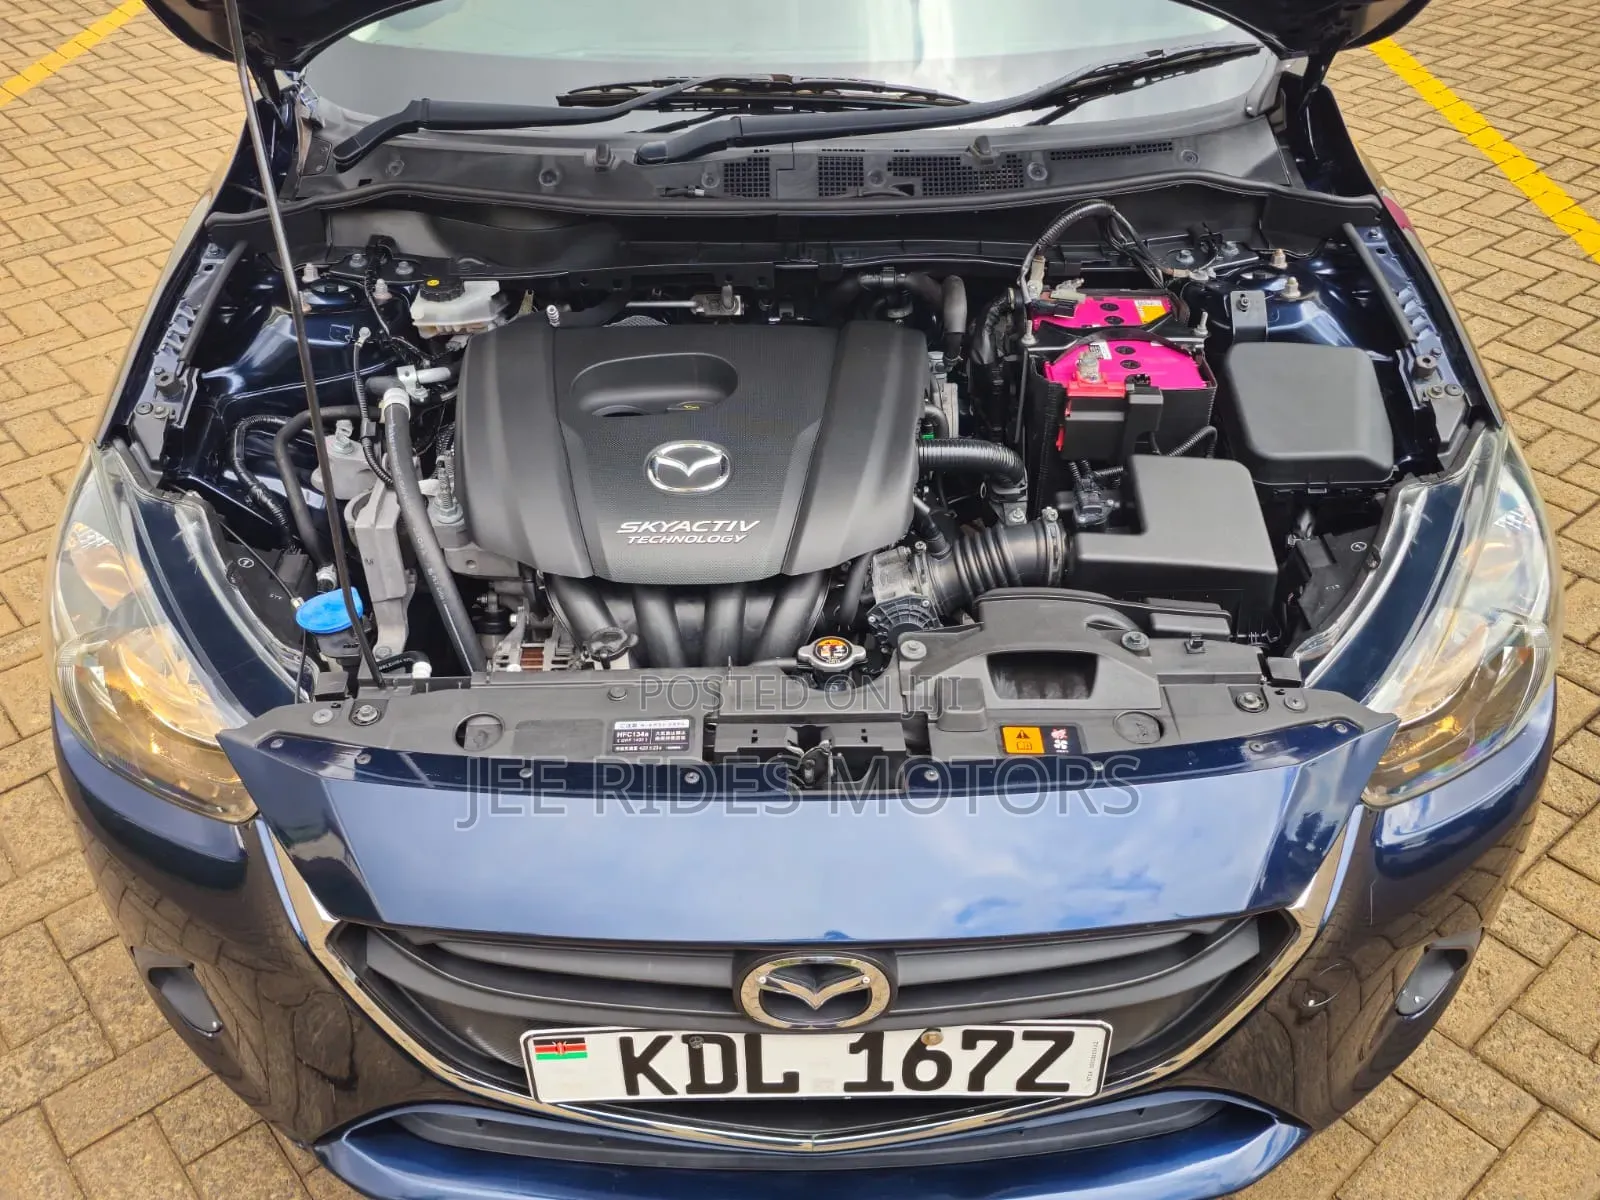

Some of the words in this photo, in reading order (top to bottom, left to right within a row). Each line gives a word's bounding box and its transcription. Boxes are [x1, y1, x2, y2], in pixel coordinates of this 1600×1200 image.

[616, 520, 760, 534] SKYACTIV
[627, 534, 747, 544] TECHNOLOGY
[619, 1033, 800, 1096] KDL
[843, 1027, 1075, 1092] 167Z
